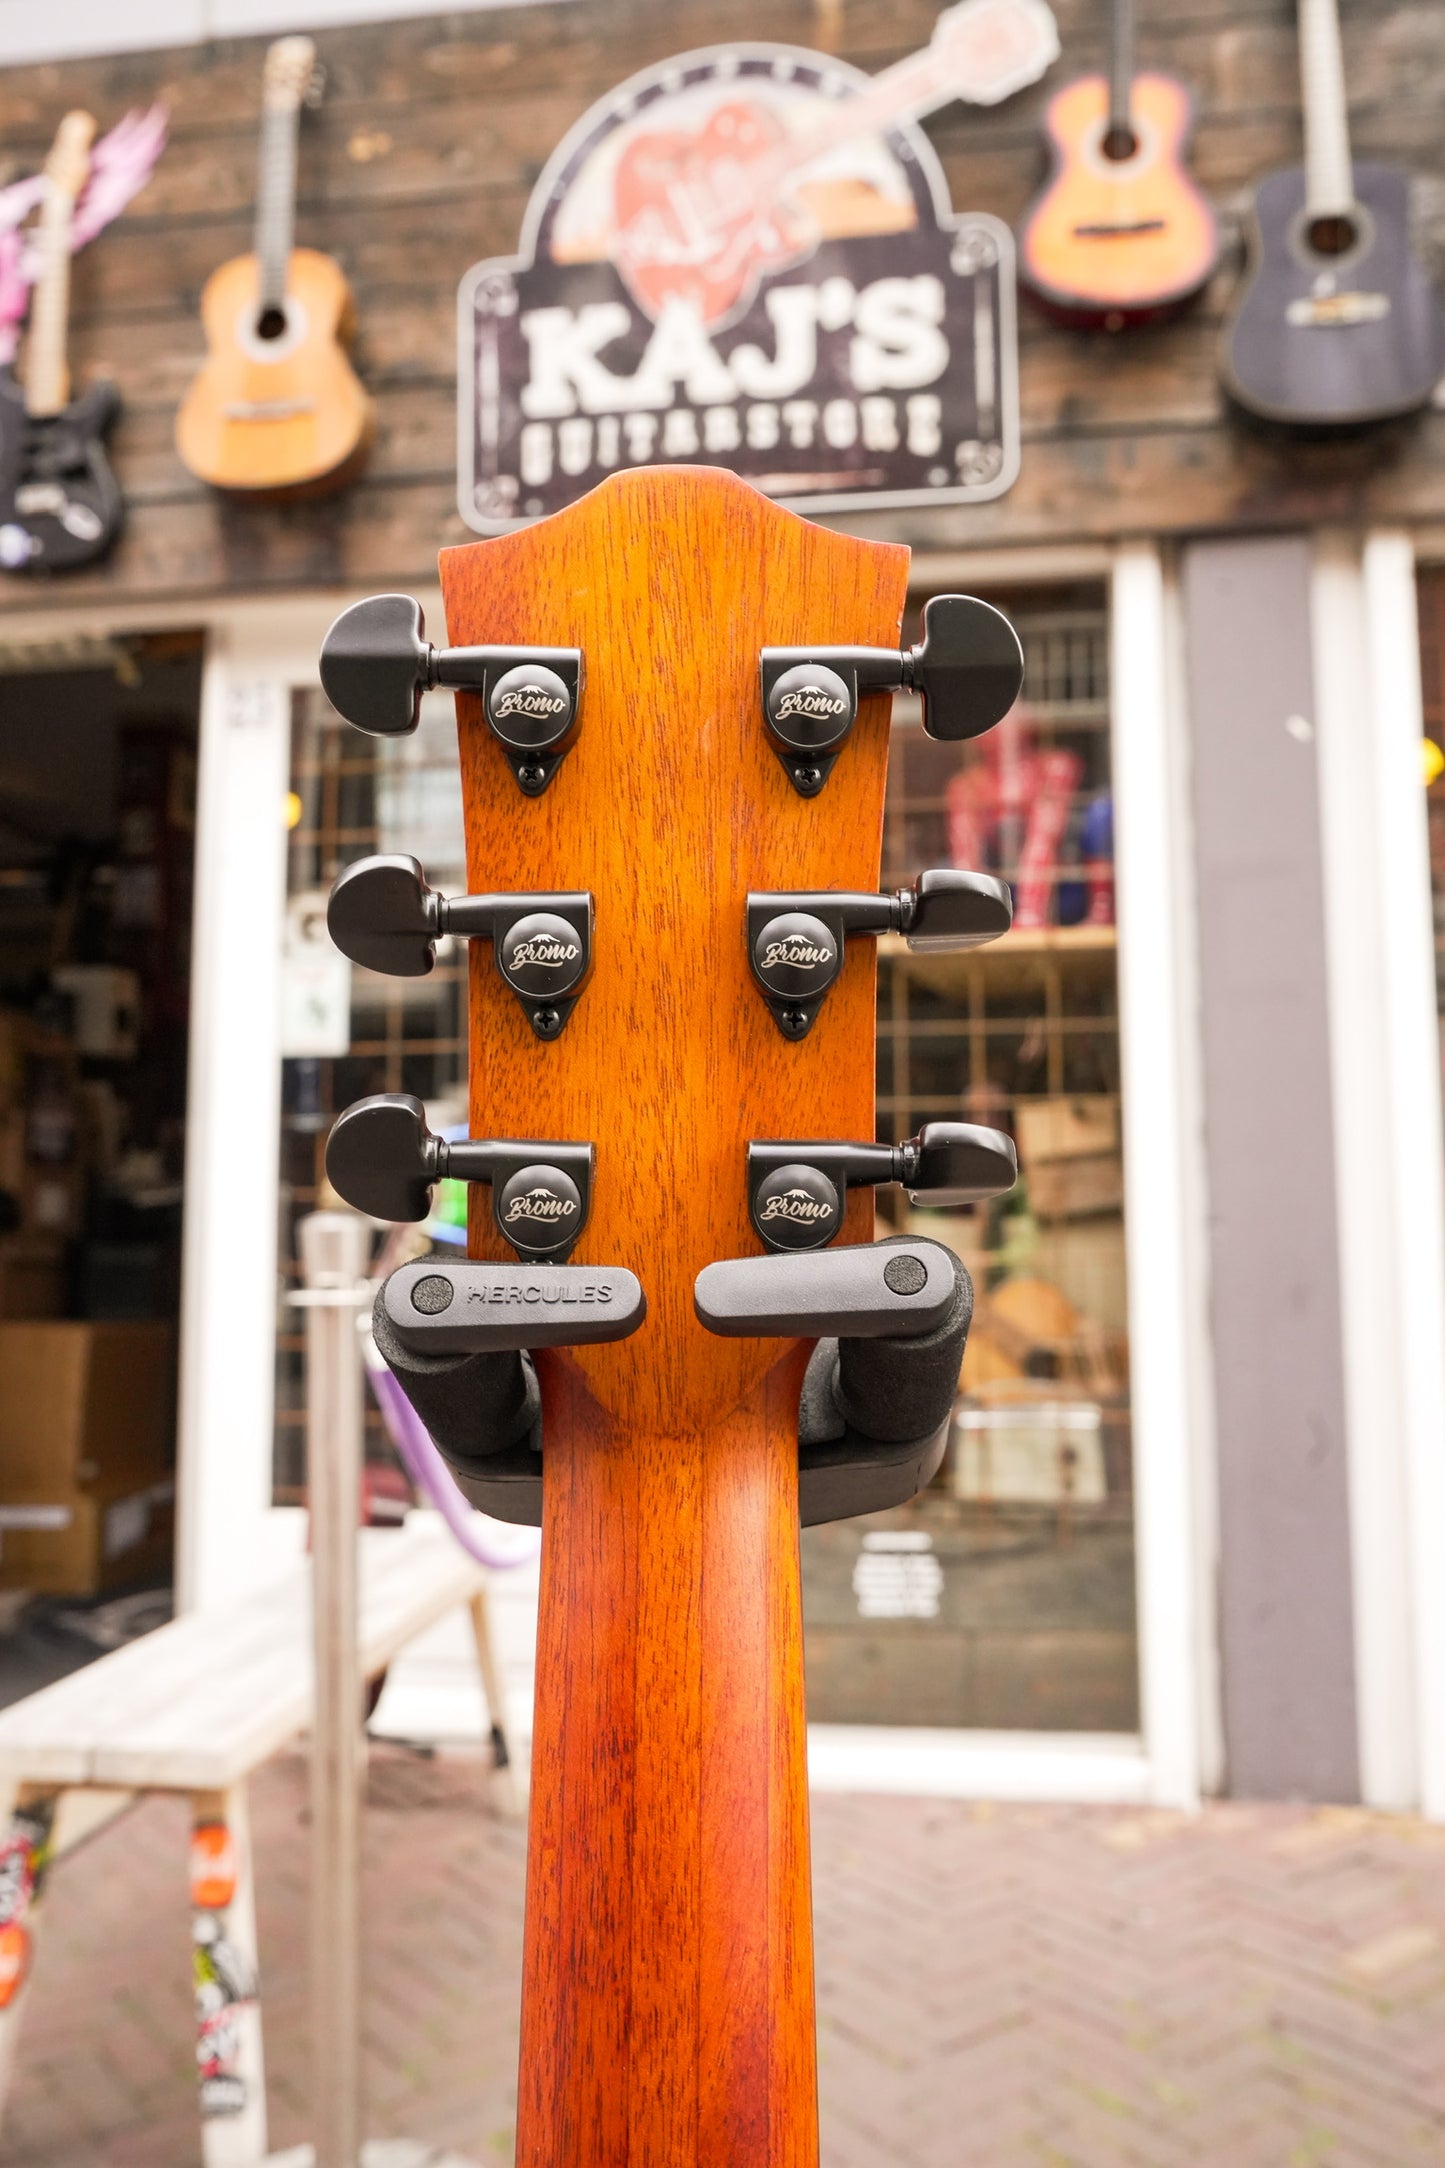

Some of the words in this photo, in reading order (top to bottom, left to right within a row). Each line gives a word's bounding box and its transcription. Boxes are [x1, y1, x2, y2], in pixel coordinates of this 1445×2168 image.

[521, 274, 950, 418] KAJ'S
[495, 693, 566, 719] Bromo
[775, 693, 846, 720] Bromo
[509, 943, 579, 970] Bromo
[761, 943, 833, 969] Bromo
[505, 1196, 577, 1223] Bromo
[760, 1196, 833, 1225] Bromo
[467, 1286, 612, 1304] HERCULES
